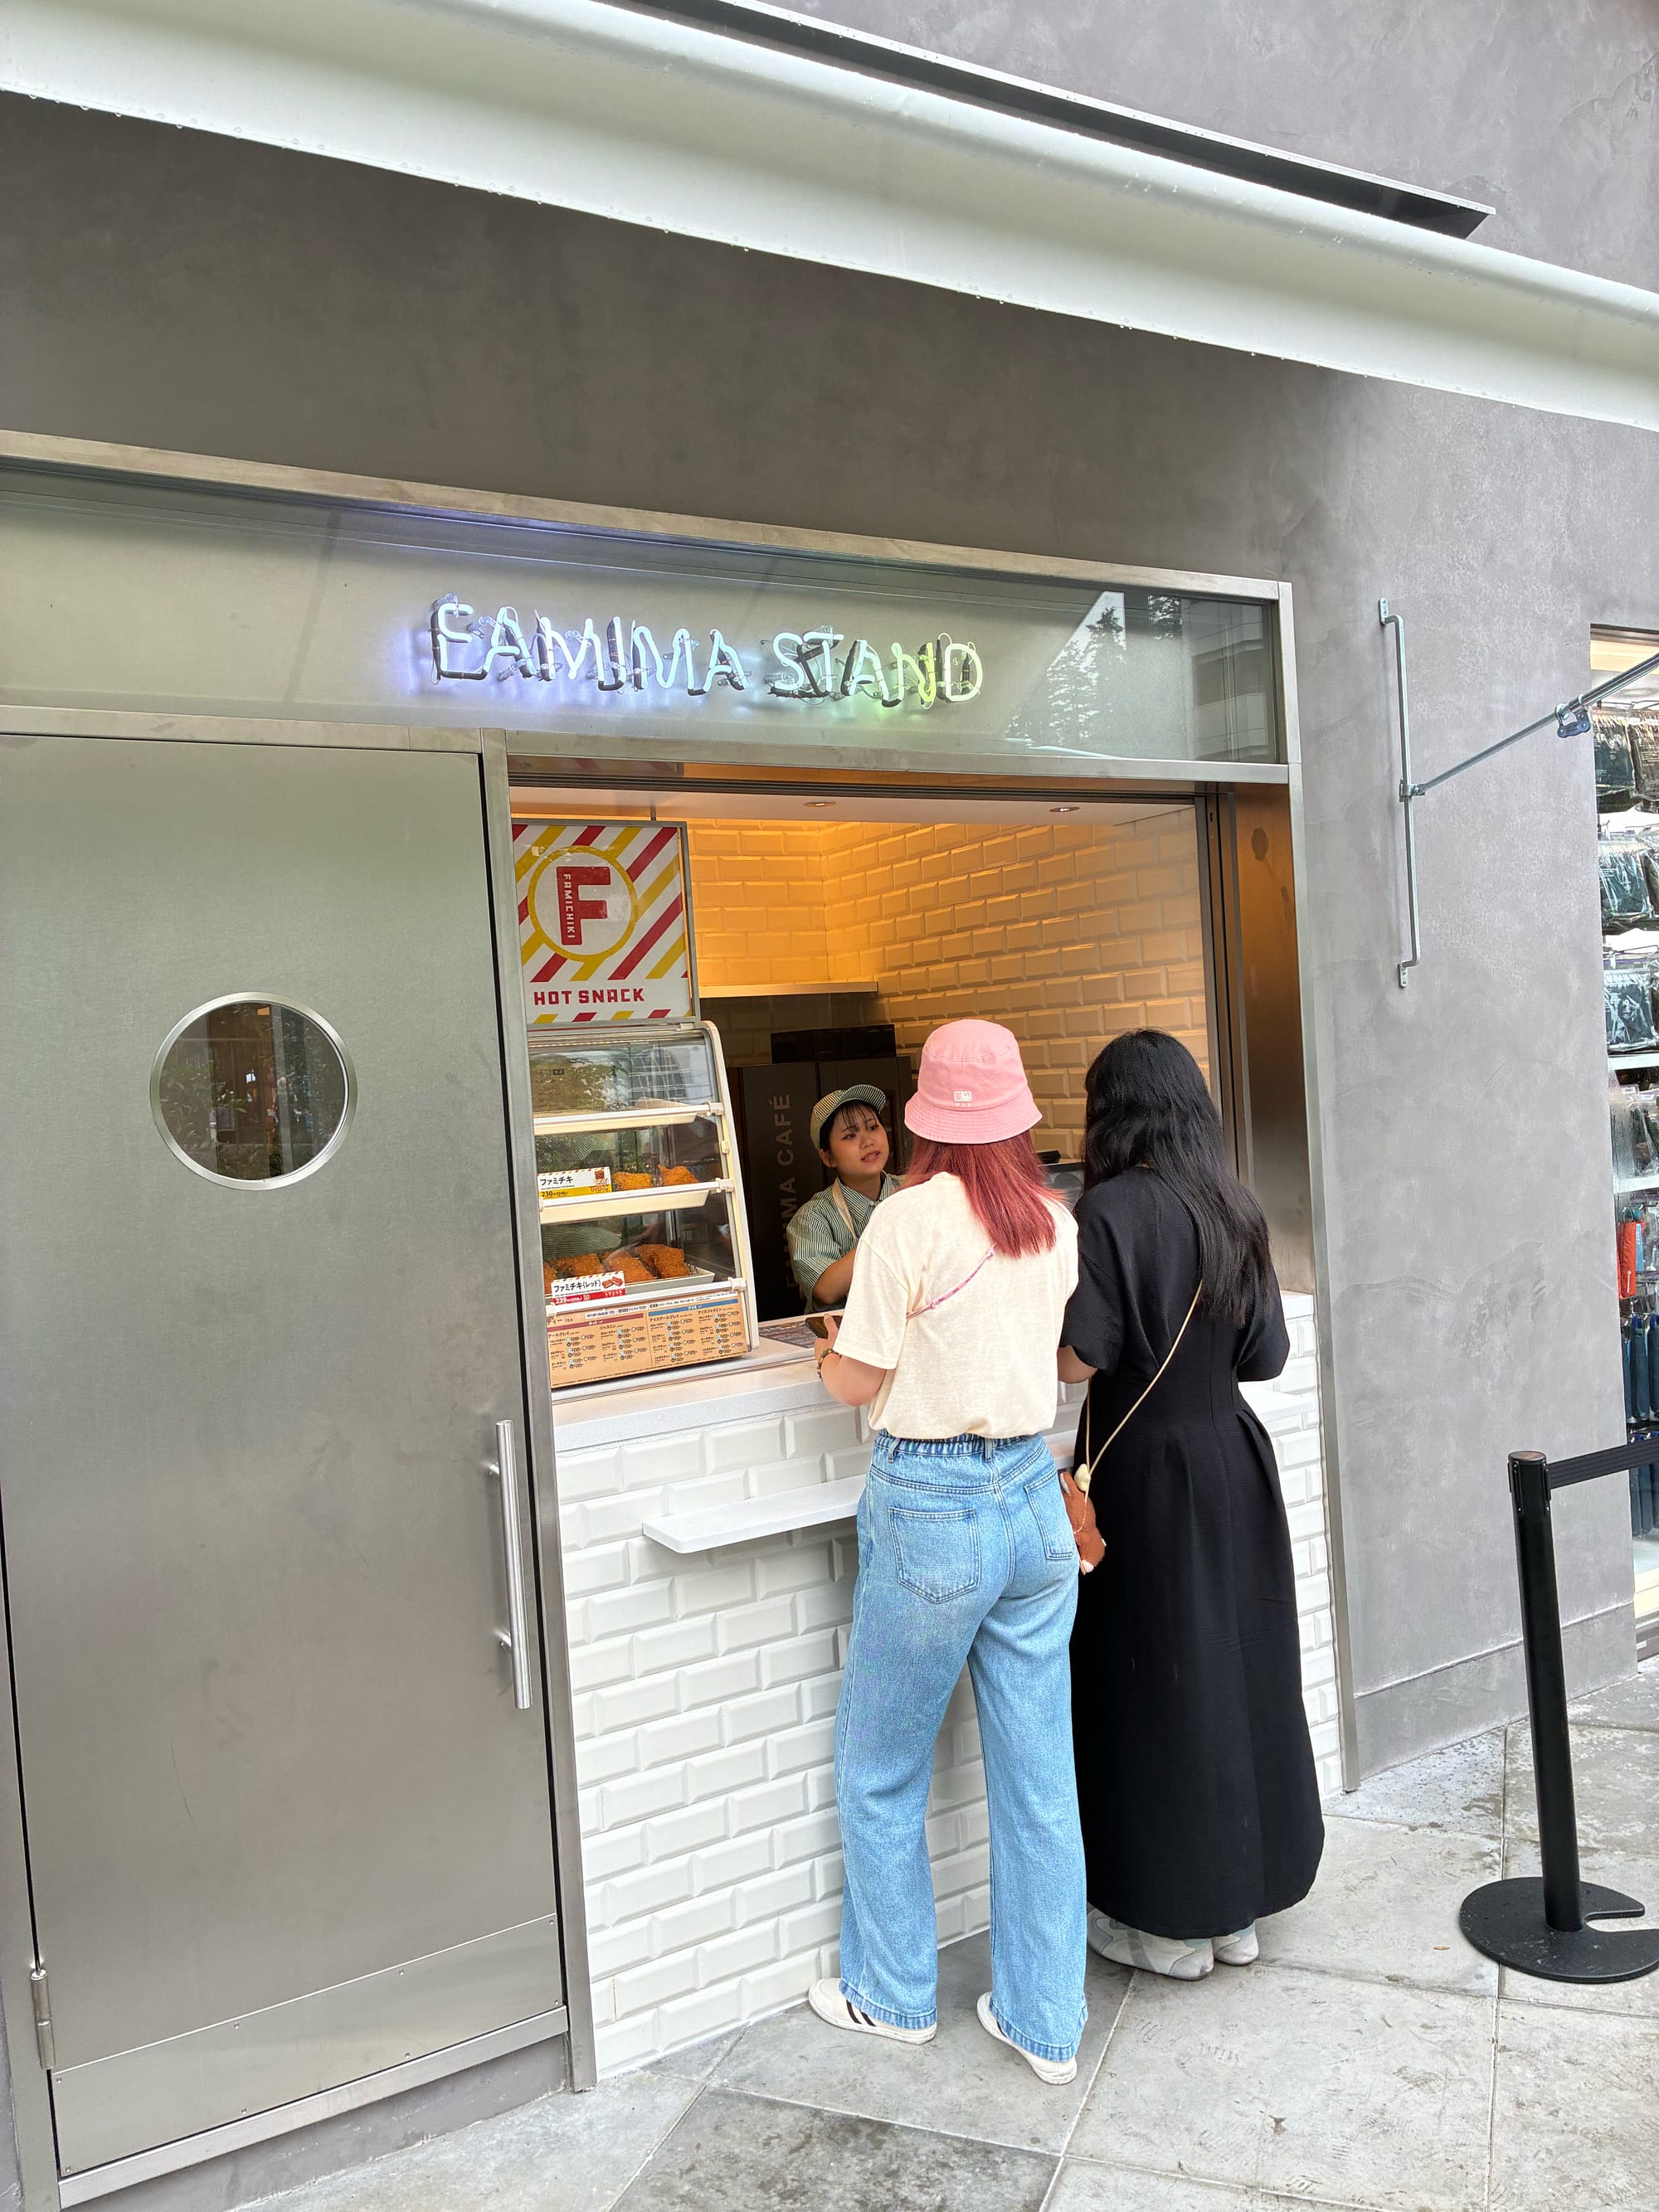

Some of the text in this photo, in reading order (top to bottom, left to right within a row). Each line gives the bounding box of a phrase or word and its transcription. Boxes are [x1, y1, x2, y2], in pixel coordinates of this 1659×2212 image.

[432, 602, 985, 707] FAMIMA STAND
[556, 866, 611, 946] F
[562, 873, 576, 939] FAMICHIKI
[533, 988, 645, 1005] HOT SNACK
[769, 1094, 795, 1166] CAFÉ
[540, 1175, 573, 1186] ファミチキ
[553, 1279, 601, 1292] ファミチキ(レッド)
